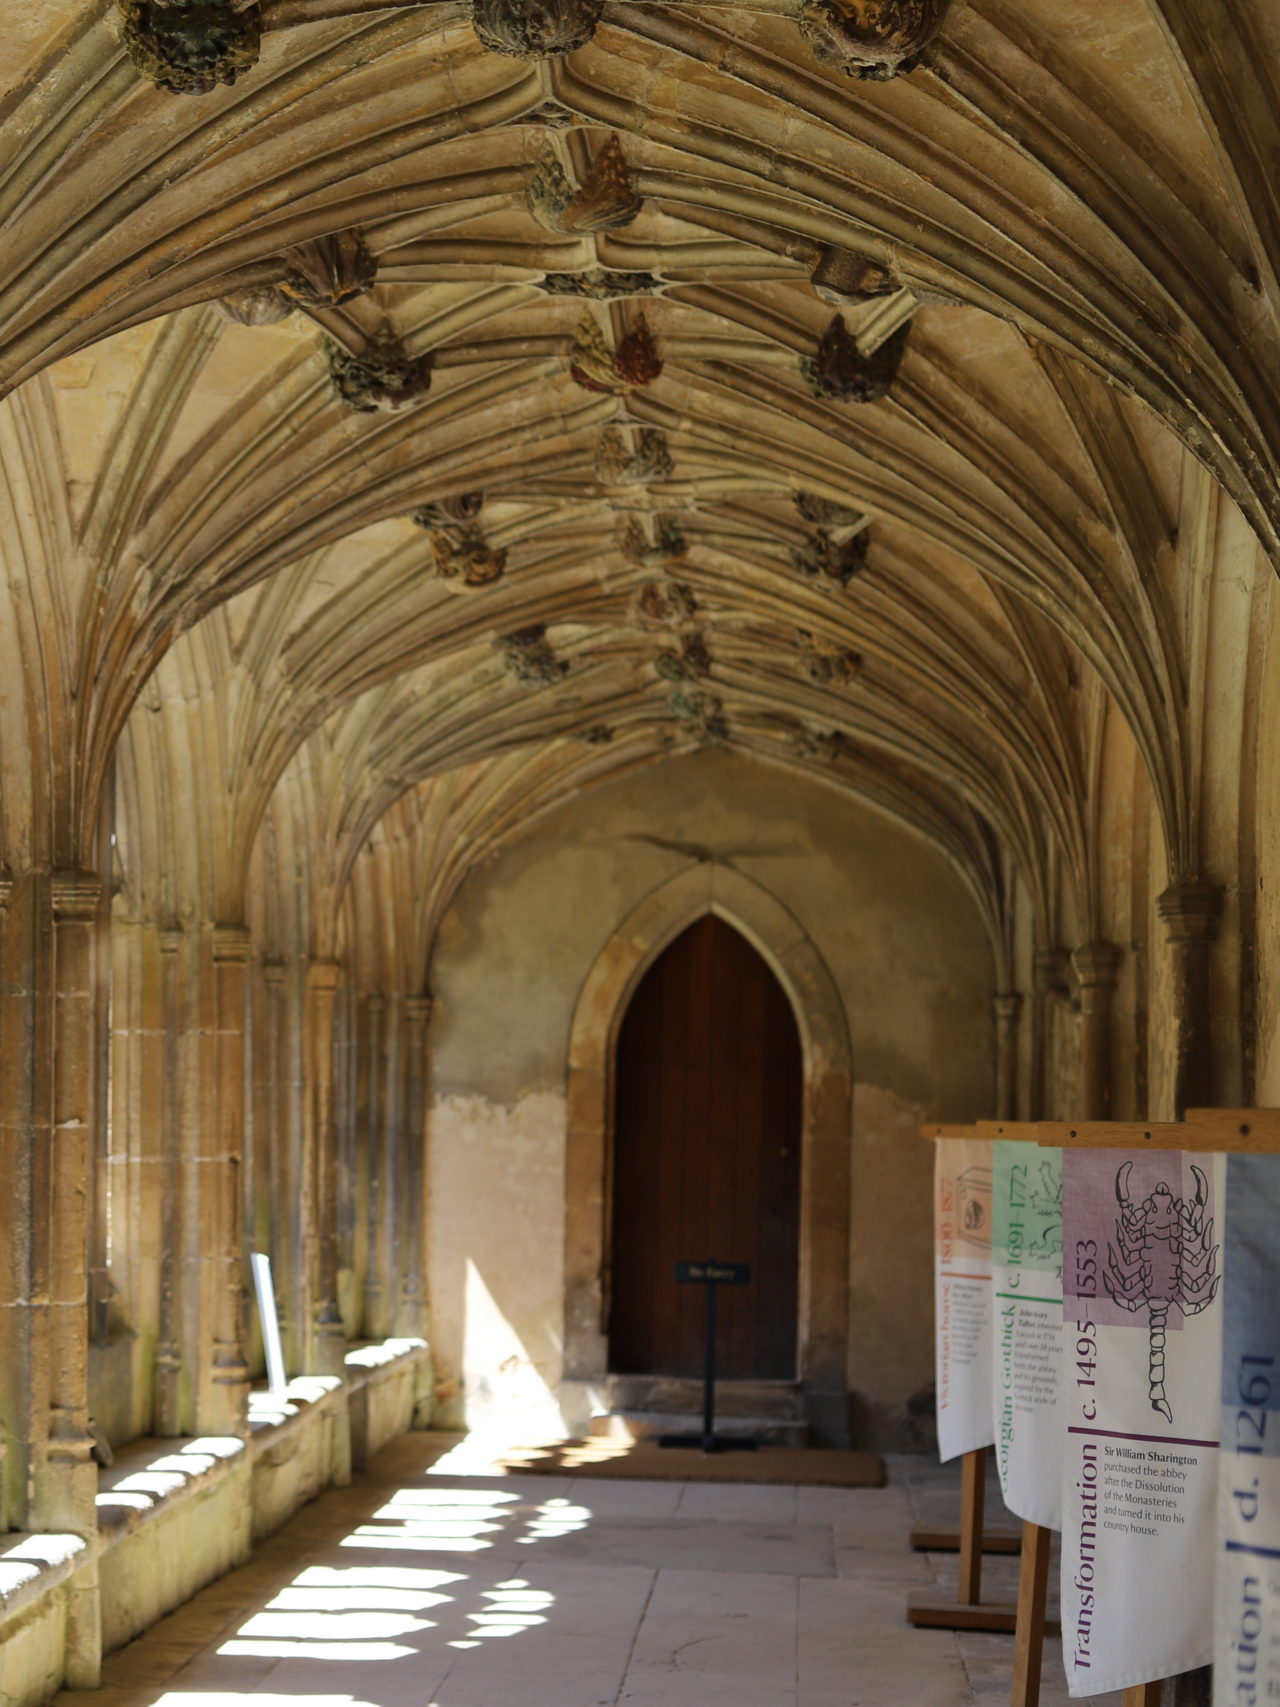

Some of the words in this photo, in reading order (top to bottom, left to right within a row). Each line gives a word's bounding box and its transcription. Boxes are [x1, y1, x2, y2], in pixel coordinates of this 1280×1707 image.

[1076, 1239, 1097, 1388] 1495–1553
[1000, 1305, 1016, 1389] Gothick
[1008, 1273, 1020, 1289] c.
[1082, 1398, 1097, 1421] c.
[1236, 1356, 1275, 1456] 1261
[1104, 1446, 1115, 1456] Sir
[1116, 1447, 1146, 1460] William
[1147, 1451, 1198, 1467] Sharington
[1104, 1463, 1141, 1475] purchased
[1143, 1465, 1159, 1477] the
[1160, 1468, 1187, 1481] abbey
[1104, 1475, 1120, 1486] after
[1121, 1477, 1133, 1488] the
[1135, 1479, 1185, 1494] Dissolution
[1104, 1490, 1112, 1500] of
[1112, 1491, 1124, 1502] the
[1125, 1492, 1177, 1508] Monasteries
[1233, 1478, 1259, 1523] d.
[1104, 1505, 1117, 1515] and
[1118, 1508, 1143, 1520] turned
[1144, 1511, 1152, 1520] it
[1154, 1511, 1172, 1523] into
[1173, 1513, 1185, 1525] his
[1104, 1520, 1129, 1535] country
[1130, 1523, 1160, 1536] house.
[1074, 1443, 1098, 1672] Transformation
